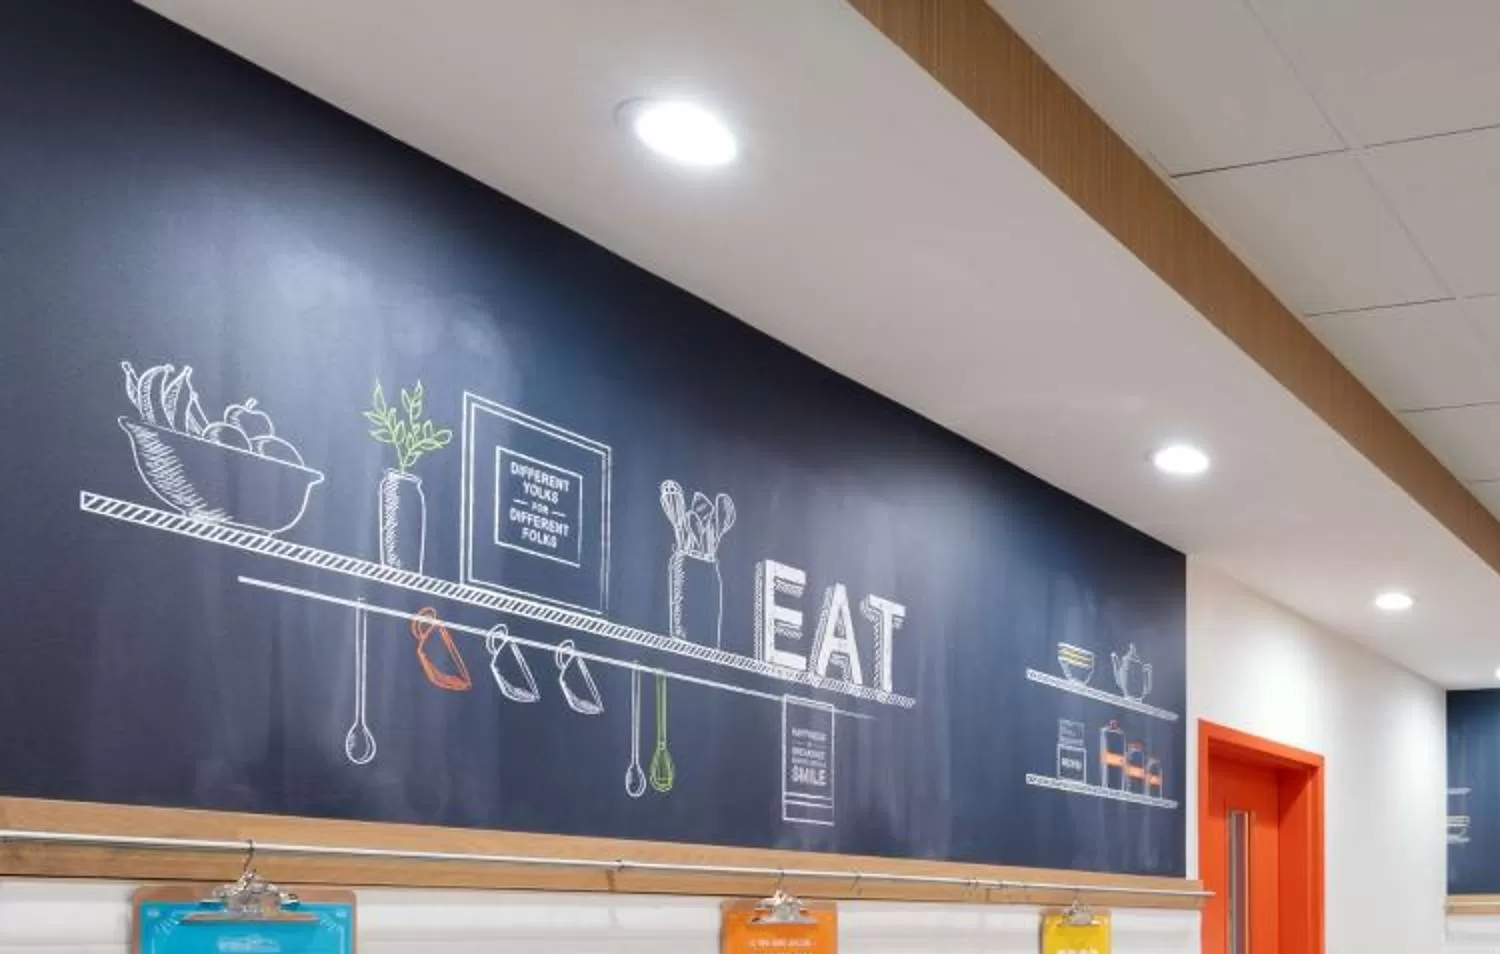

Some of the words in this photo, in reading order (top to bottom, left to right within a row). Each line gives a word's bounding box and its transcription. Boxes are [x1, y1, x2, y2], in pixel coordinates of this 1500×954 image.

[510, 461, 570, 493] DIFFERENT
[523, 481, 559, 505] YOLKS
[509, 507, 570, 537] DIFFERENT
[521, 527, 557, 549] FOLKS
[754, 559, 906, 693] EAT
